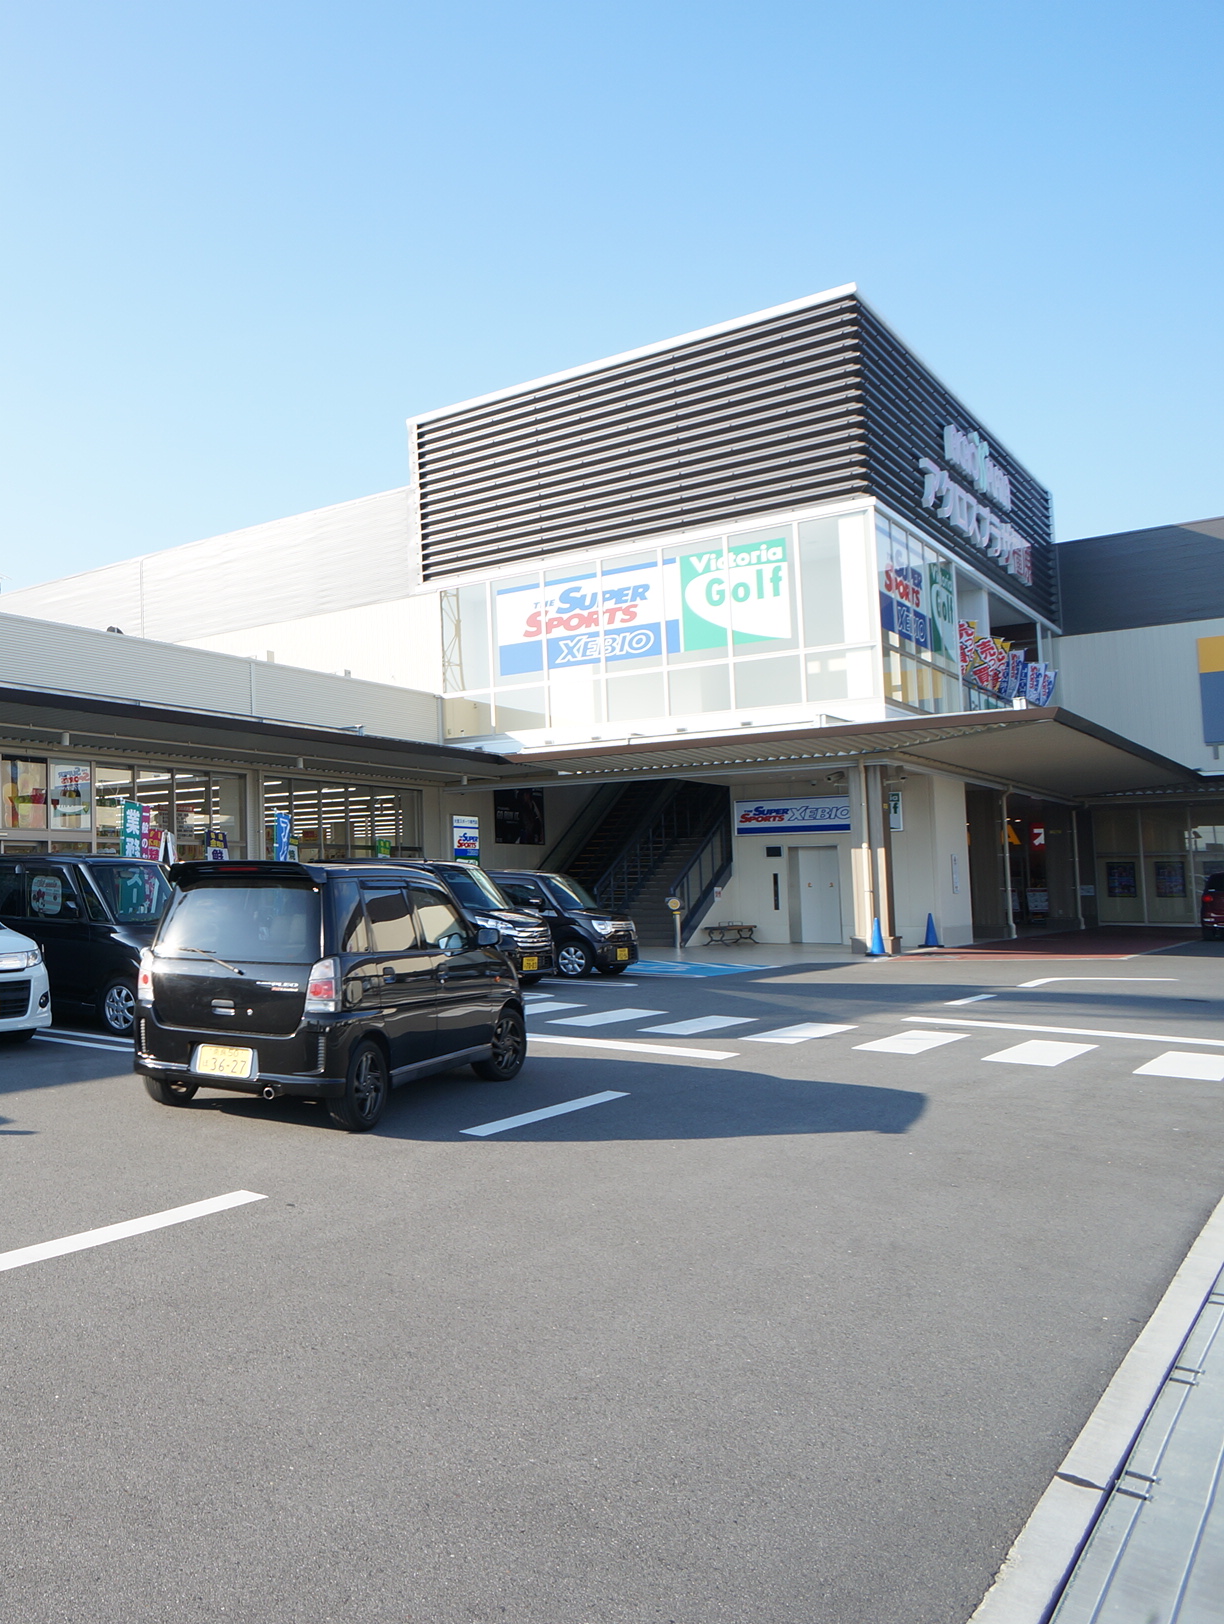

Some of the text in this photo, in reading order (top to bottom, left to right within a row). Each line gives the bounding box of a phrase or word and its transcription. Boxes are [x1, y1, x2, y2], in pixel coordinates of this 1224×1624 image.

[690, 543, 783, 574] Victoria
[705, 565, 783, 607] Golf
[555, 629, 655, 664] XEBIO
[739, 813, 785, 824] SPORTS
[753, 806, 790, 816] SUPER
[210, 1057, 247, 1074] 36-27
